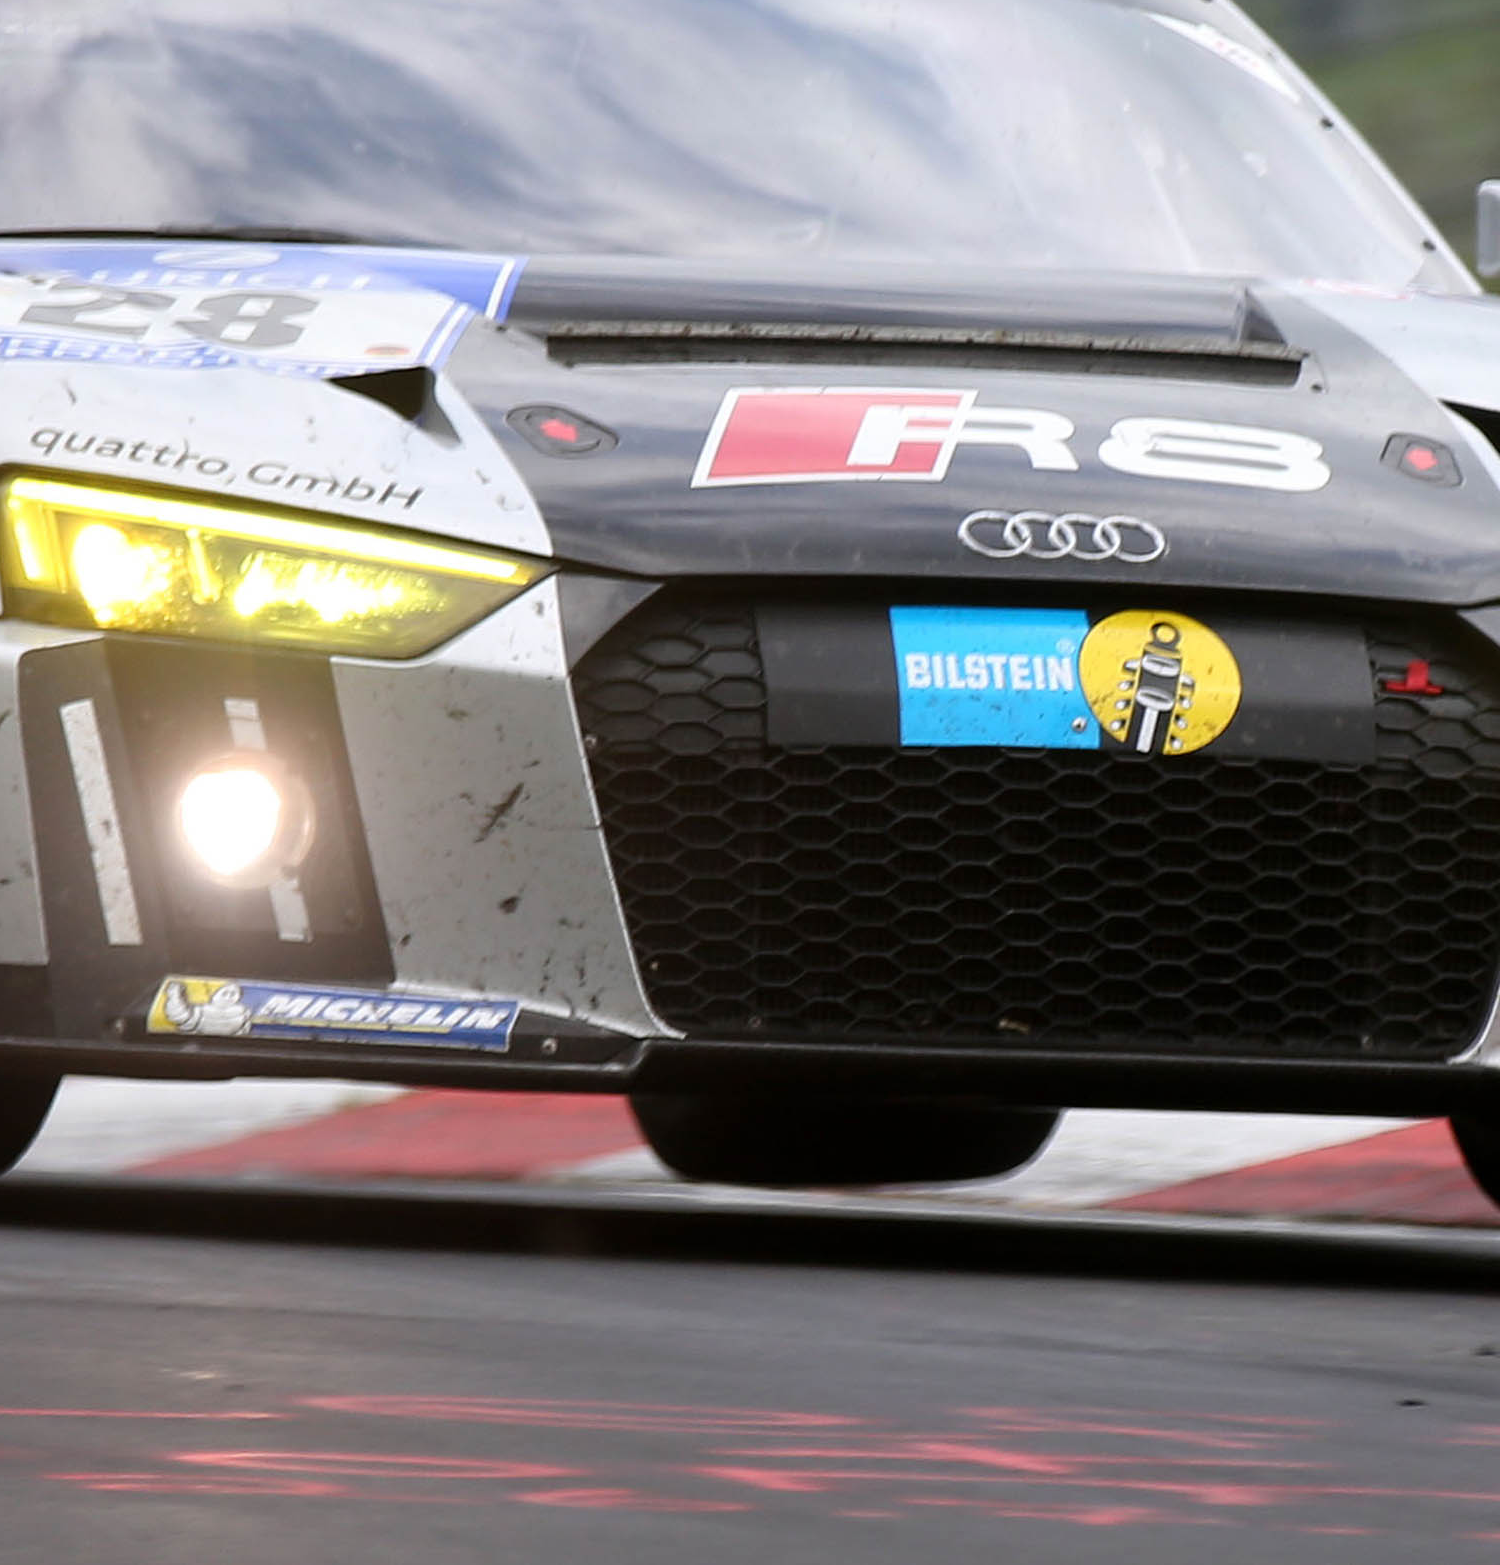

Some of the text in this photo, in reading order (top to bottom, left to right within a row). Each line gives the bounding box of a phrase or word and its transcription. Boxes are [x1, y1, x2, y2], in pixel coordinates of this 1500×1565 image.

[18, 281, 322, 350] 28
[28, 426, 428, 510] quattro GmbH
[846, 403, 1334, 492] R8
[904, 652, 1076, 692] BILSTEIN
[259, 993, 510, 1031] MICHELIN
